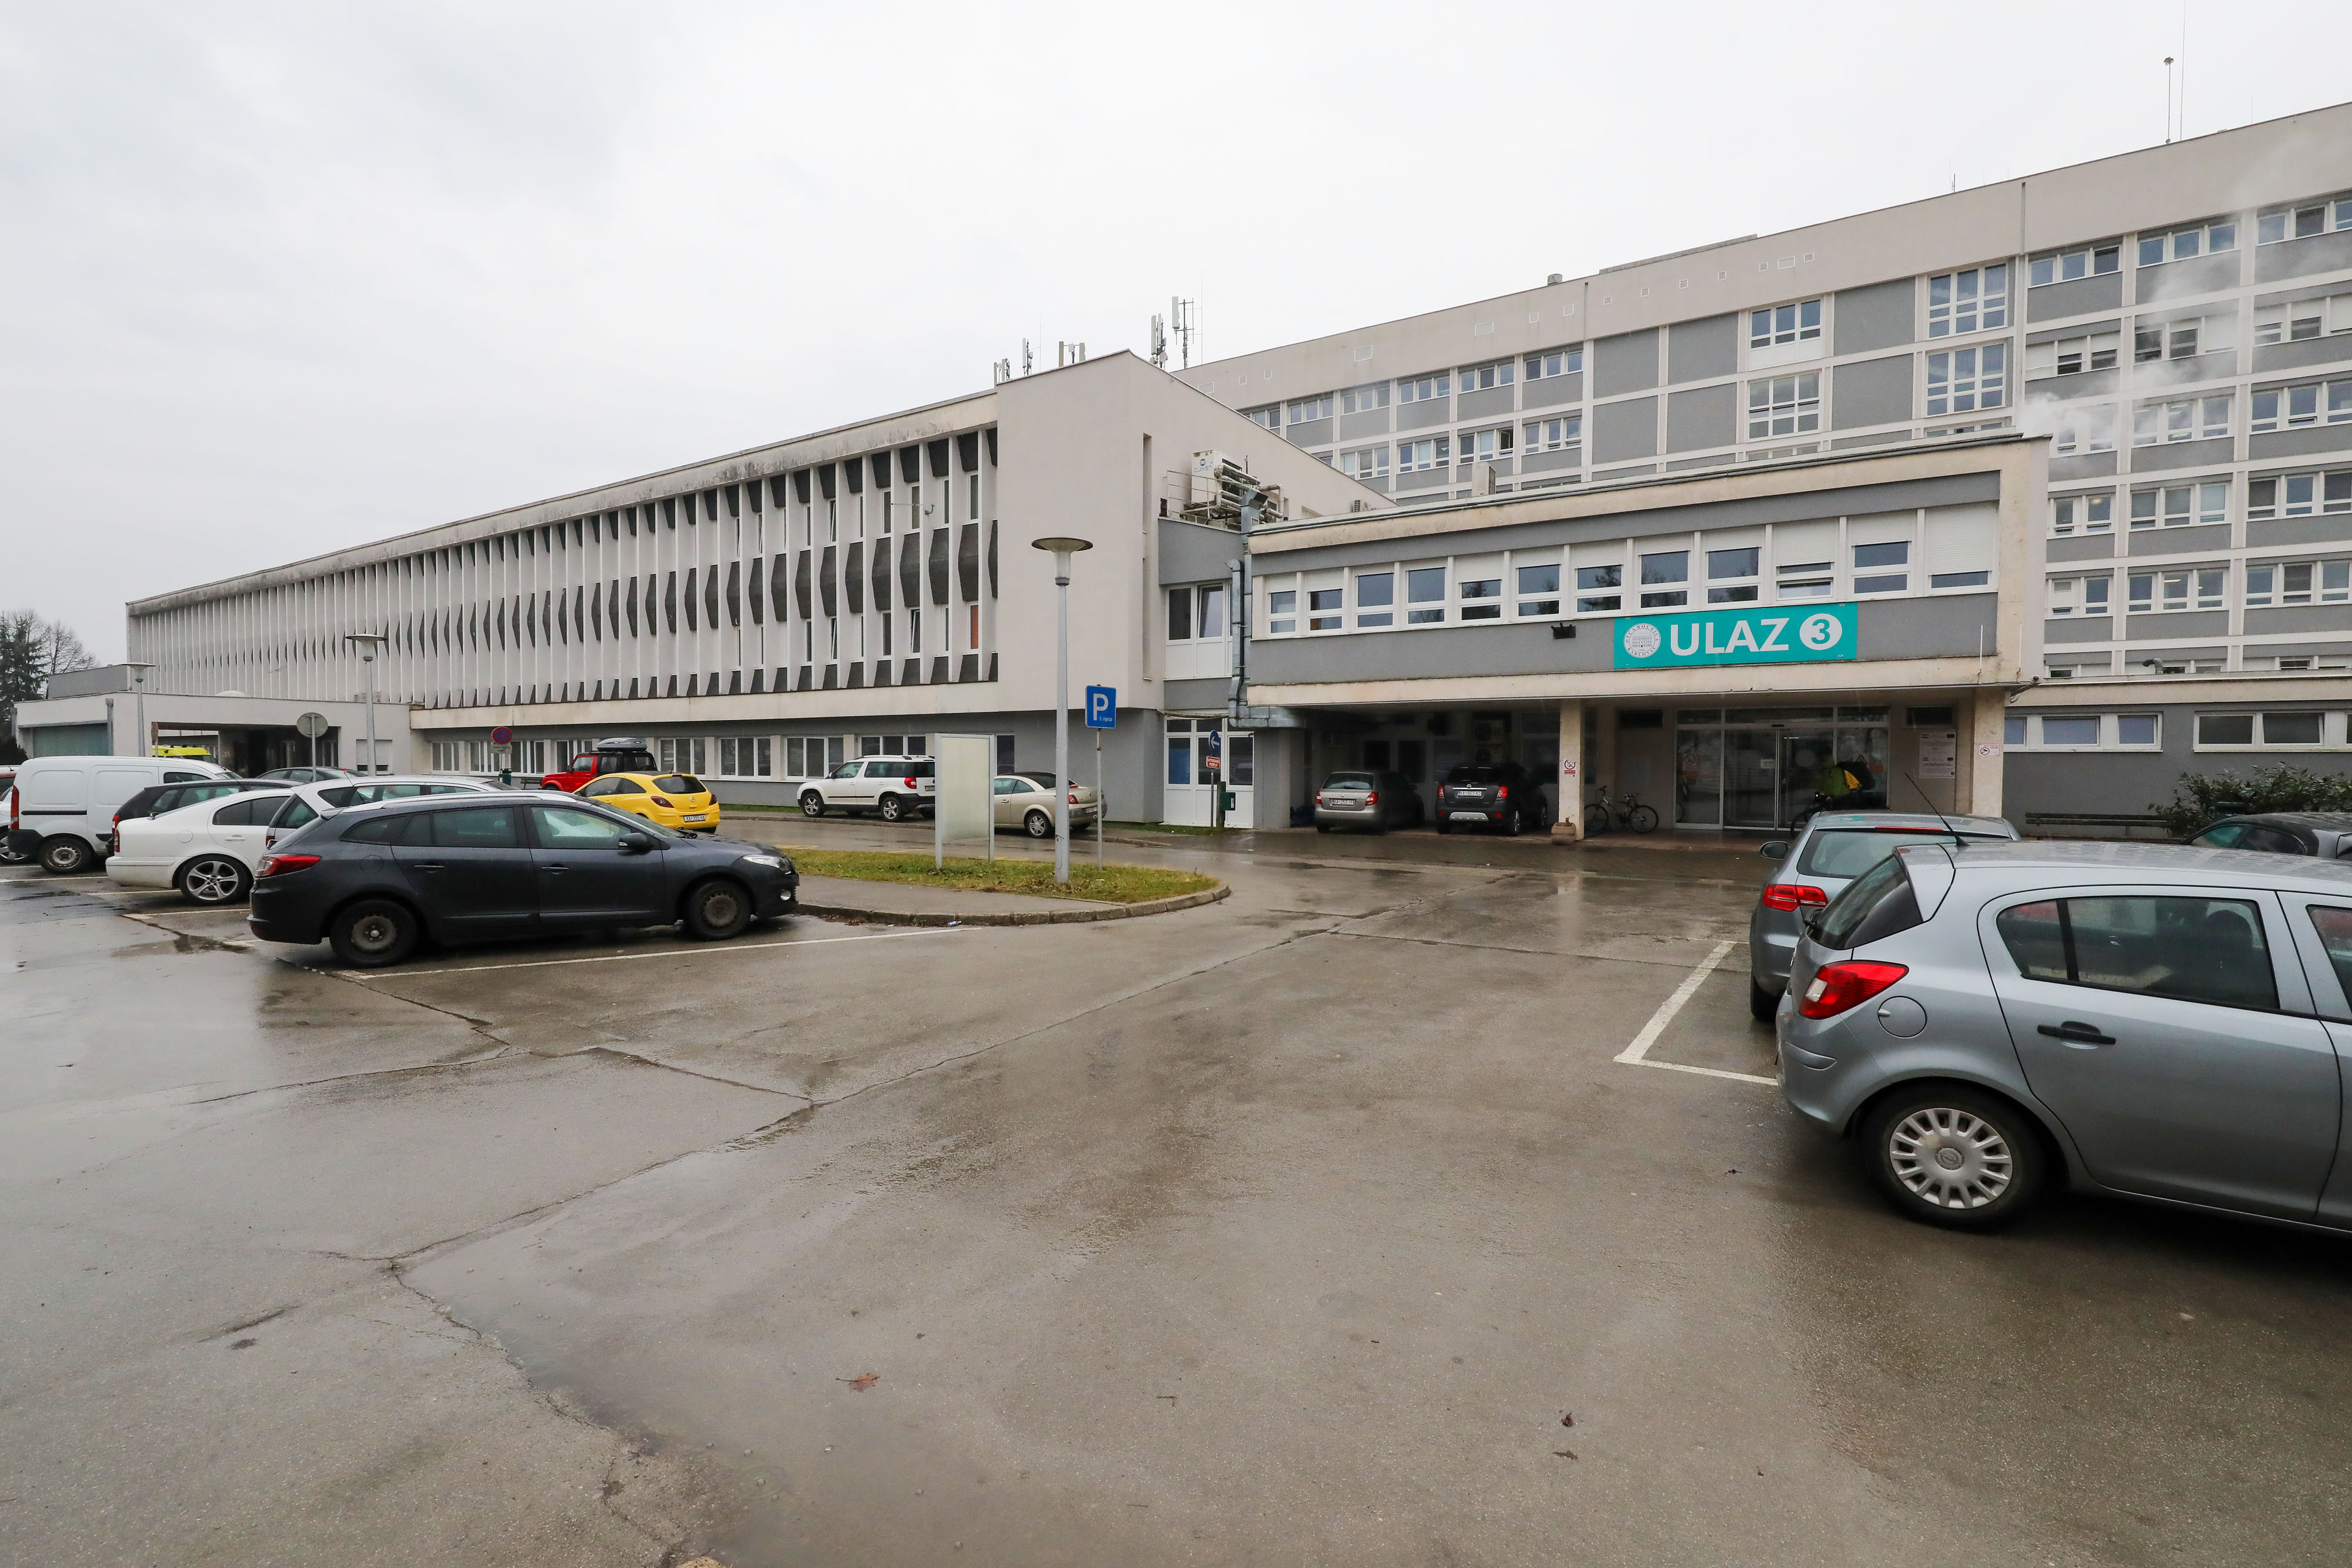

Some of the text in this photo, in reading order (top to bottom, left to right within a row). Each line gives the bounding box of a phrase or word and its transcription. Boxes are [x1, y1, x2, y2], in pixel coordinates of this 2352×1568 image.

[1671, 618, 1830, 656] ULAZ 3
[1093, 693, 1108, 721] P
